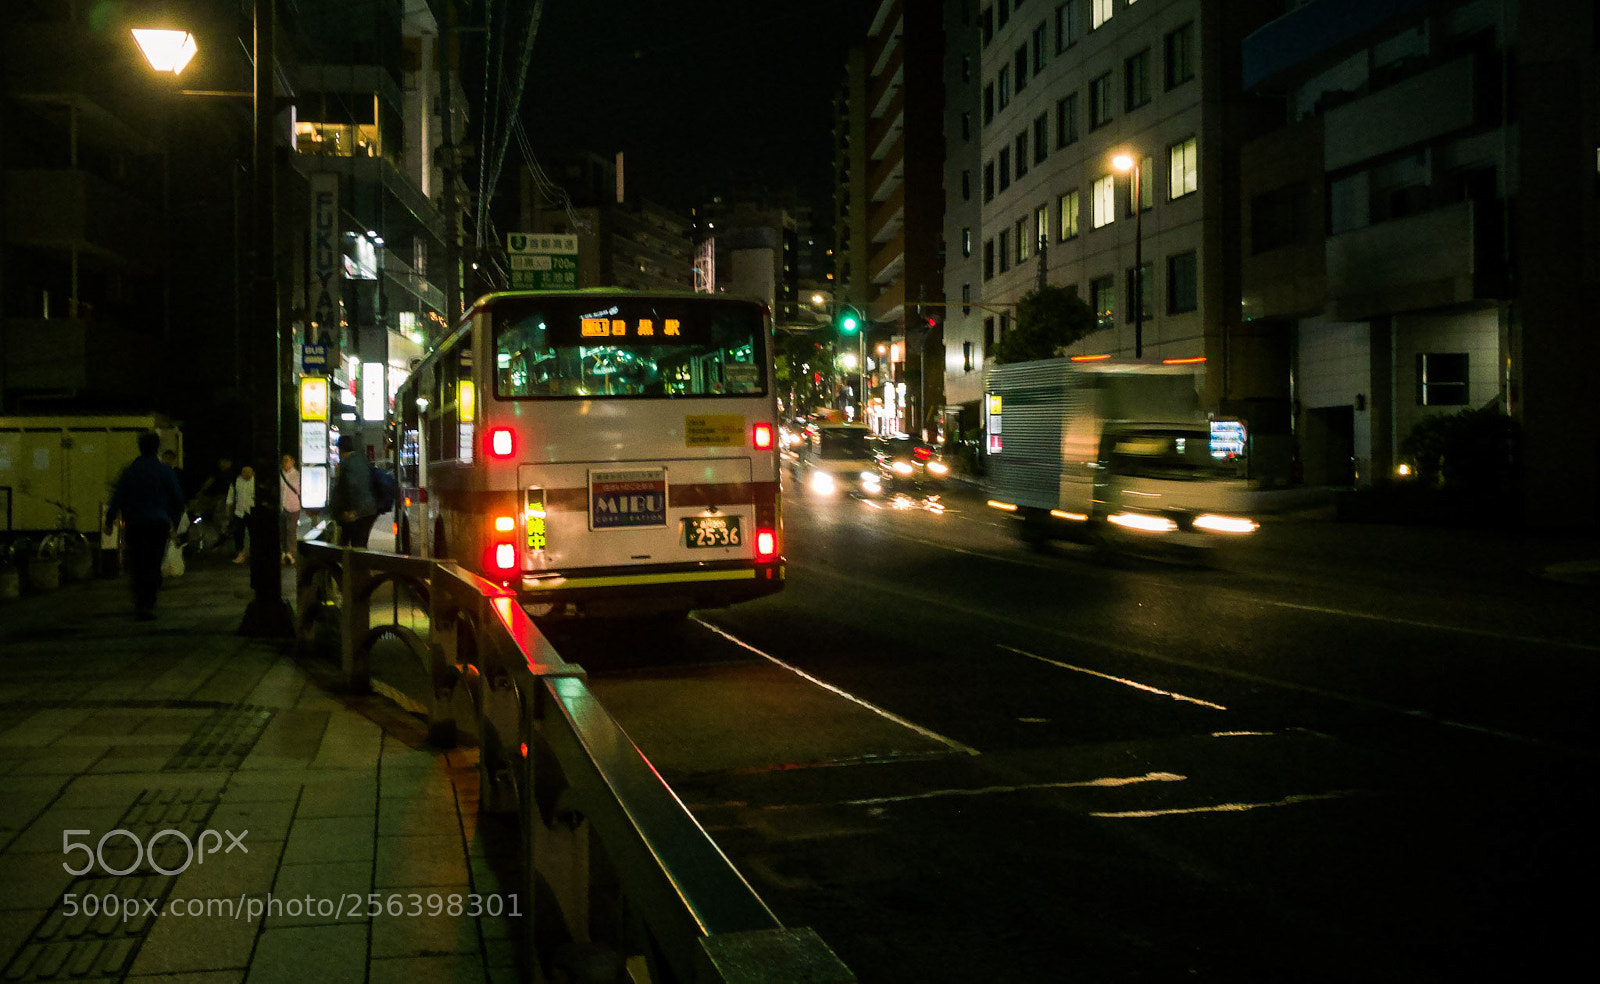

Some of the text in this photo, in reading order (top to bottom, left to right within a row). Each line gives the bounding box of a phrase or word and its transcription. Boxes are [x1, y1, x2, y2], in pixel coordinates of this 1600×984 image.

[315, 192, 334, 347] FUKUYAMA
[304, 345, 325, 355] BUS
[597, 493, 664, 514] MIBU
